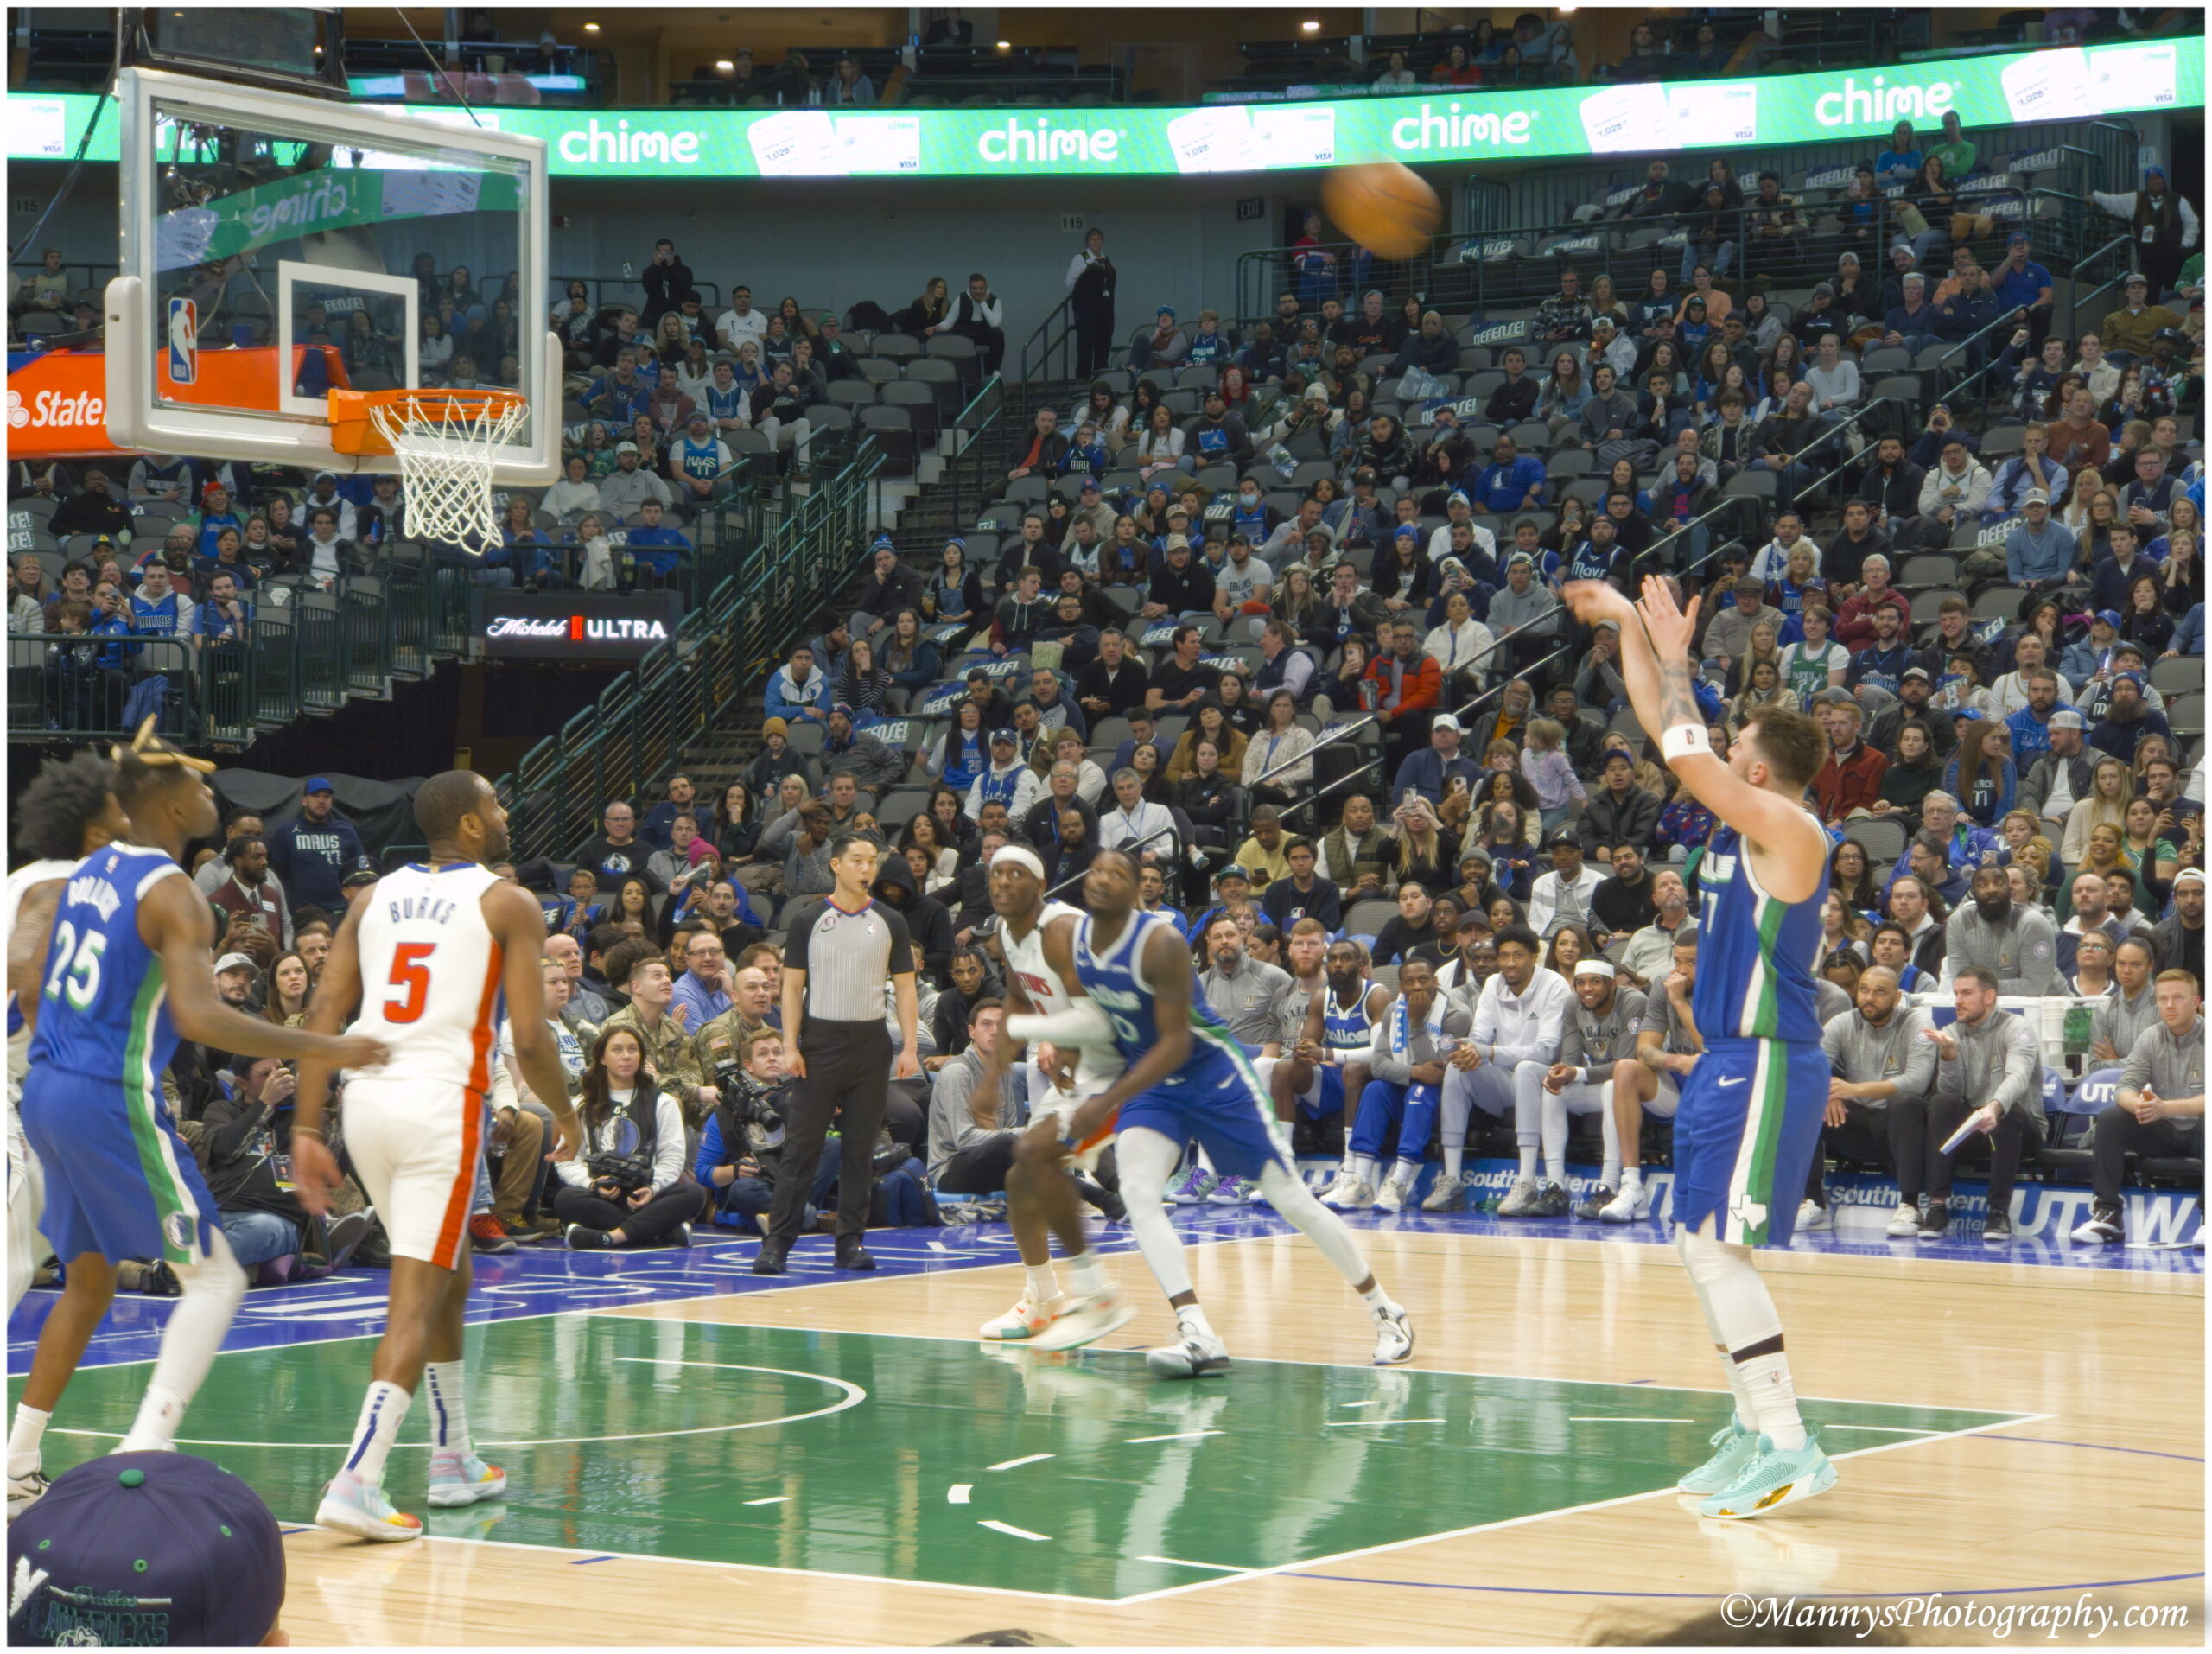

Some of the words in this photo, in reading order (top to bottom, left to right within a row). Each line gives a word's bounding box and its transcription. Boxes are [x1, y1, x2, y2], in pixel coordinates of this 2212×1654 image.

[1815, 76, 1953, 126] chime
[558, 118, 699, 163] chime
[978, 118, 1118, 162] chime
[1392, 103, 1530, 150] chime
[1805, 166, 1858, 190] DEFENSE
[16, 200, 38, 213] 115
[1062, 216, 1084, 229] 115
[1473, 320, 1525, 346] DEFENSE!
[173, 363, 188, 379] NBA
[31, 390, 103, 427] State
[487, 617, 568, 637] Michelob
[587, 619, 669, 639] ULTRA
[296, 834, 340, 850] MAVS
[321, 849, 342, 865] 77
[389, 896, 457, 926] BURKS
[45, 920, 108, 1013] 25
[383, 942, 438, 1024] 5
[1948, 1216, 1989, 1232] enter
[2010, 1189, 2196, 1244] UTW
